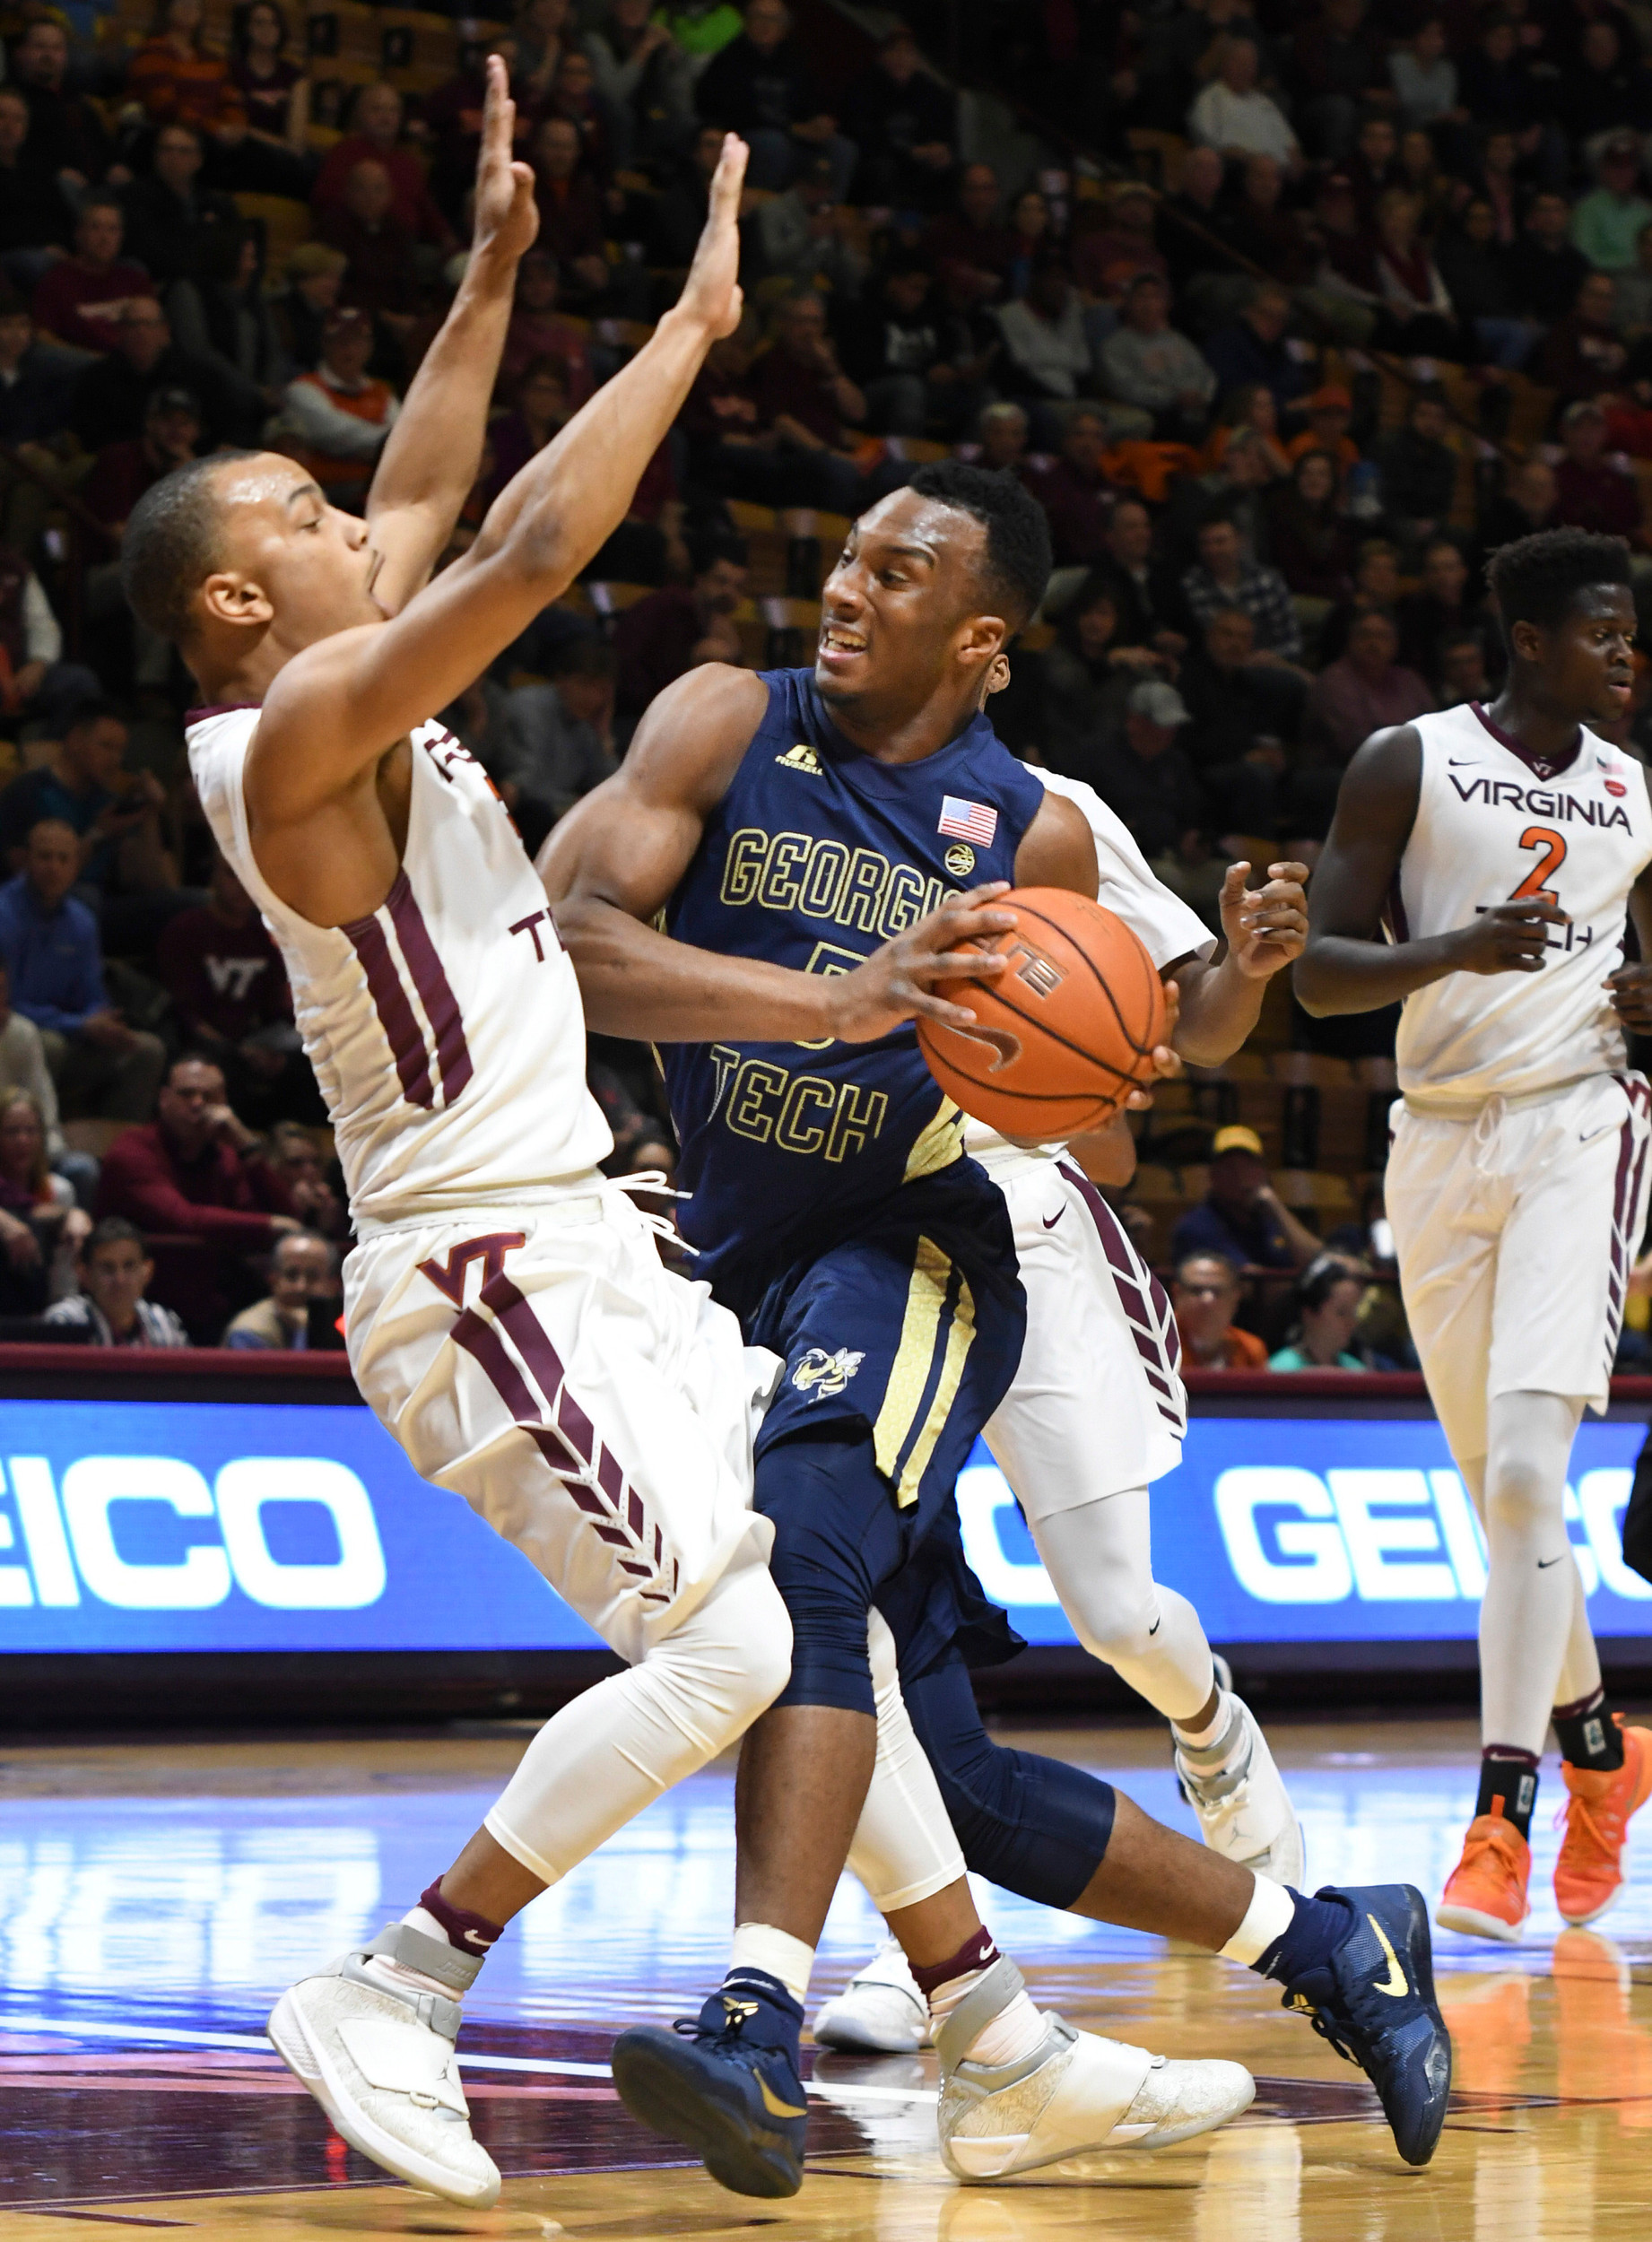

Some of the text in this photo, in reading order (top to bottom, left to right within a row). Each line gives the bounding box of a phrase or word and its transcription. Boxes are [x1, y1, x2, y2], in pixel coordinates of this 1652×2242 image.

[775, 755, 823, 777] RUSSELL
[1448, 773, 1634, 838] VIRGINIA
[720, 828, 964, 939] GEORGI
[1507, 825, 1568, 907] 2
[204, 952, 268, 999] VT
[708, 1044, 888, 1163] TECH
[415, 1231, 526, 1310] VT
